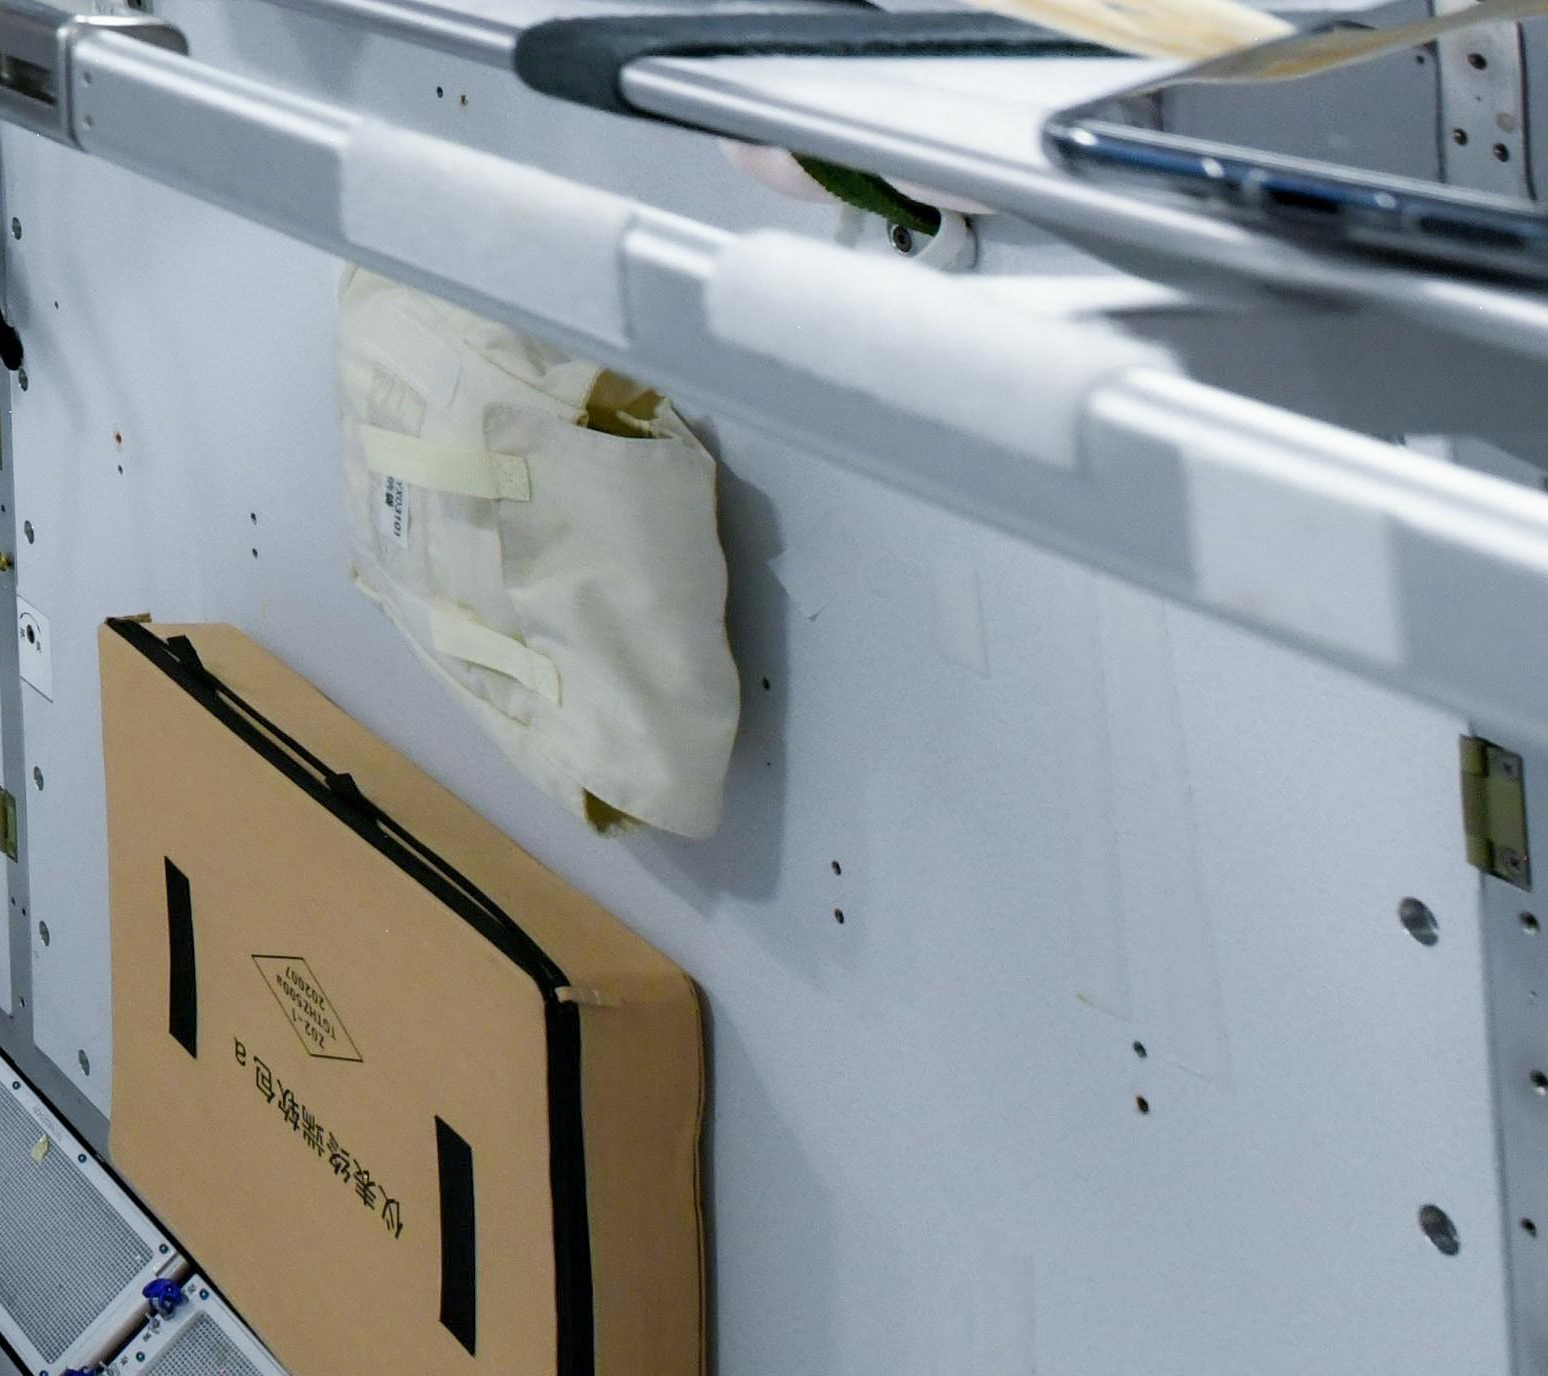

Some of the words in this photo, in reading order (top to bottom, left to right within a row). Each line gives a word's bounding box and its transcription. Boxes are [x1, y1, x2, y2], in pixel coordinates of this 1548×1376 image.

[290, 1005, 325, 1050] Z02-1
[253, 1052, 404, 1239] 仪表终端软包
